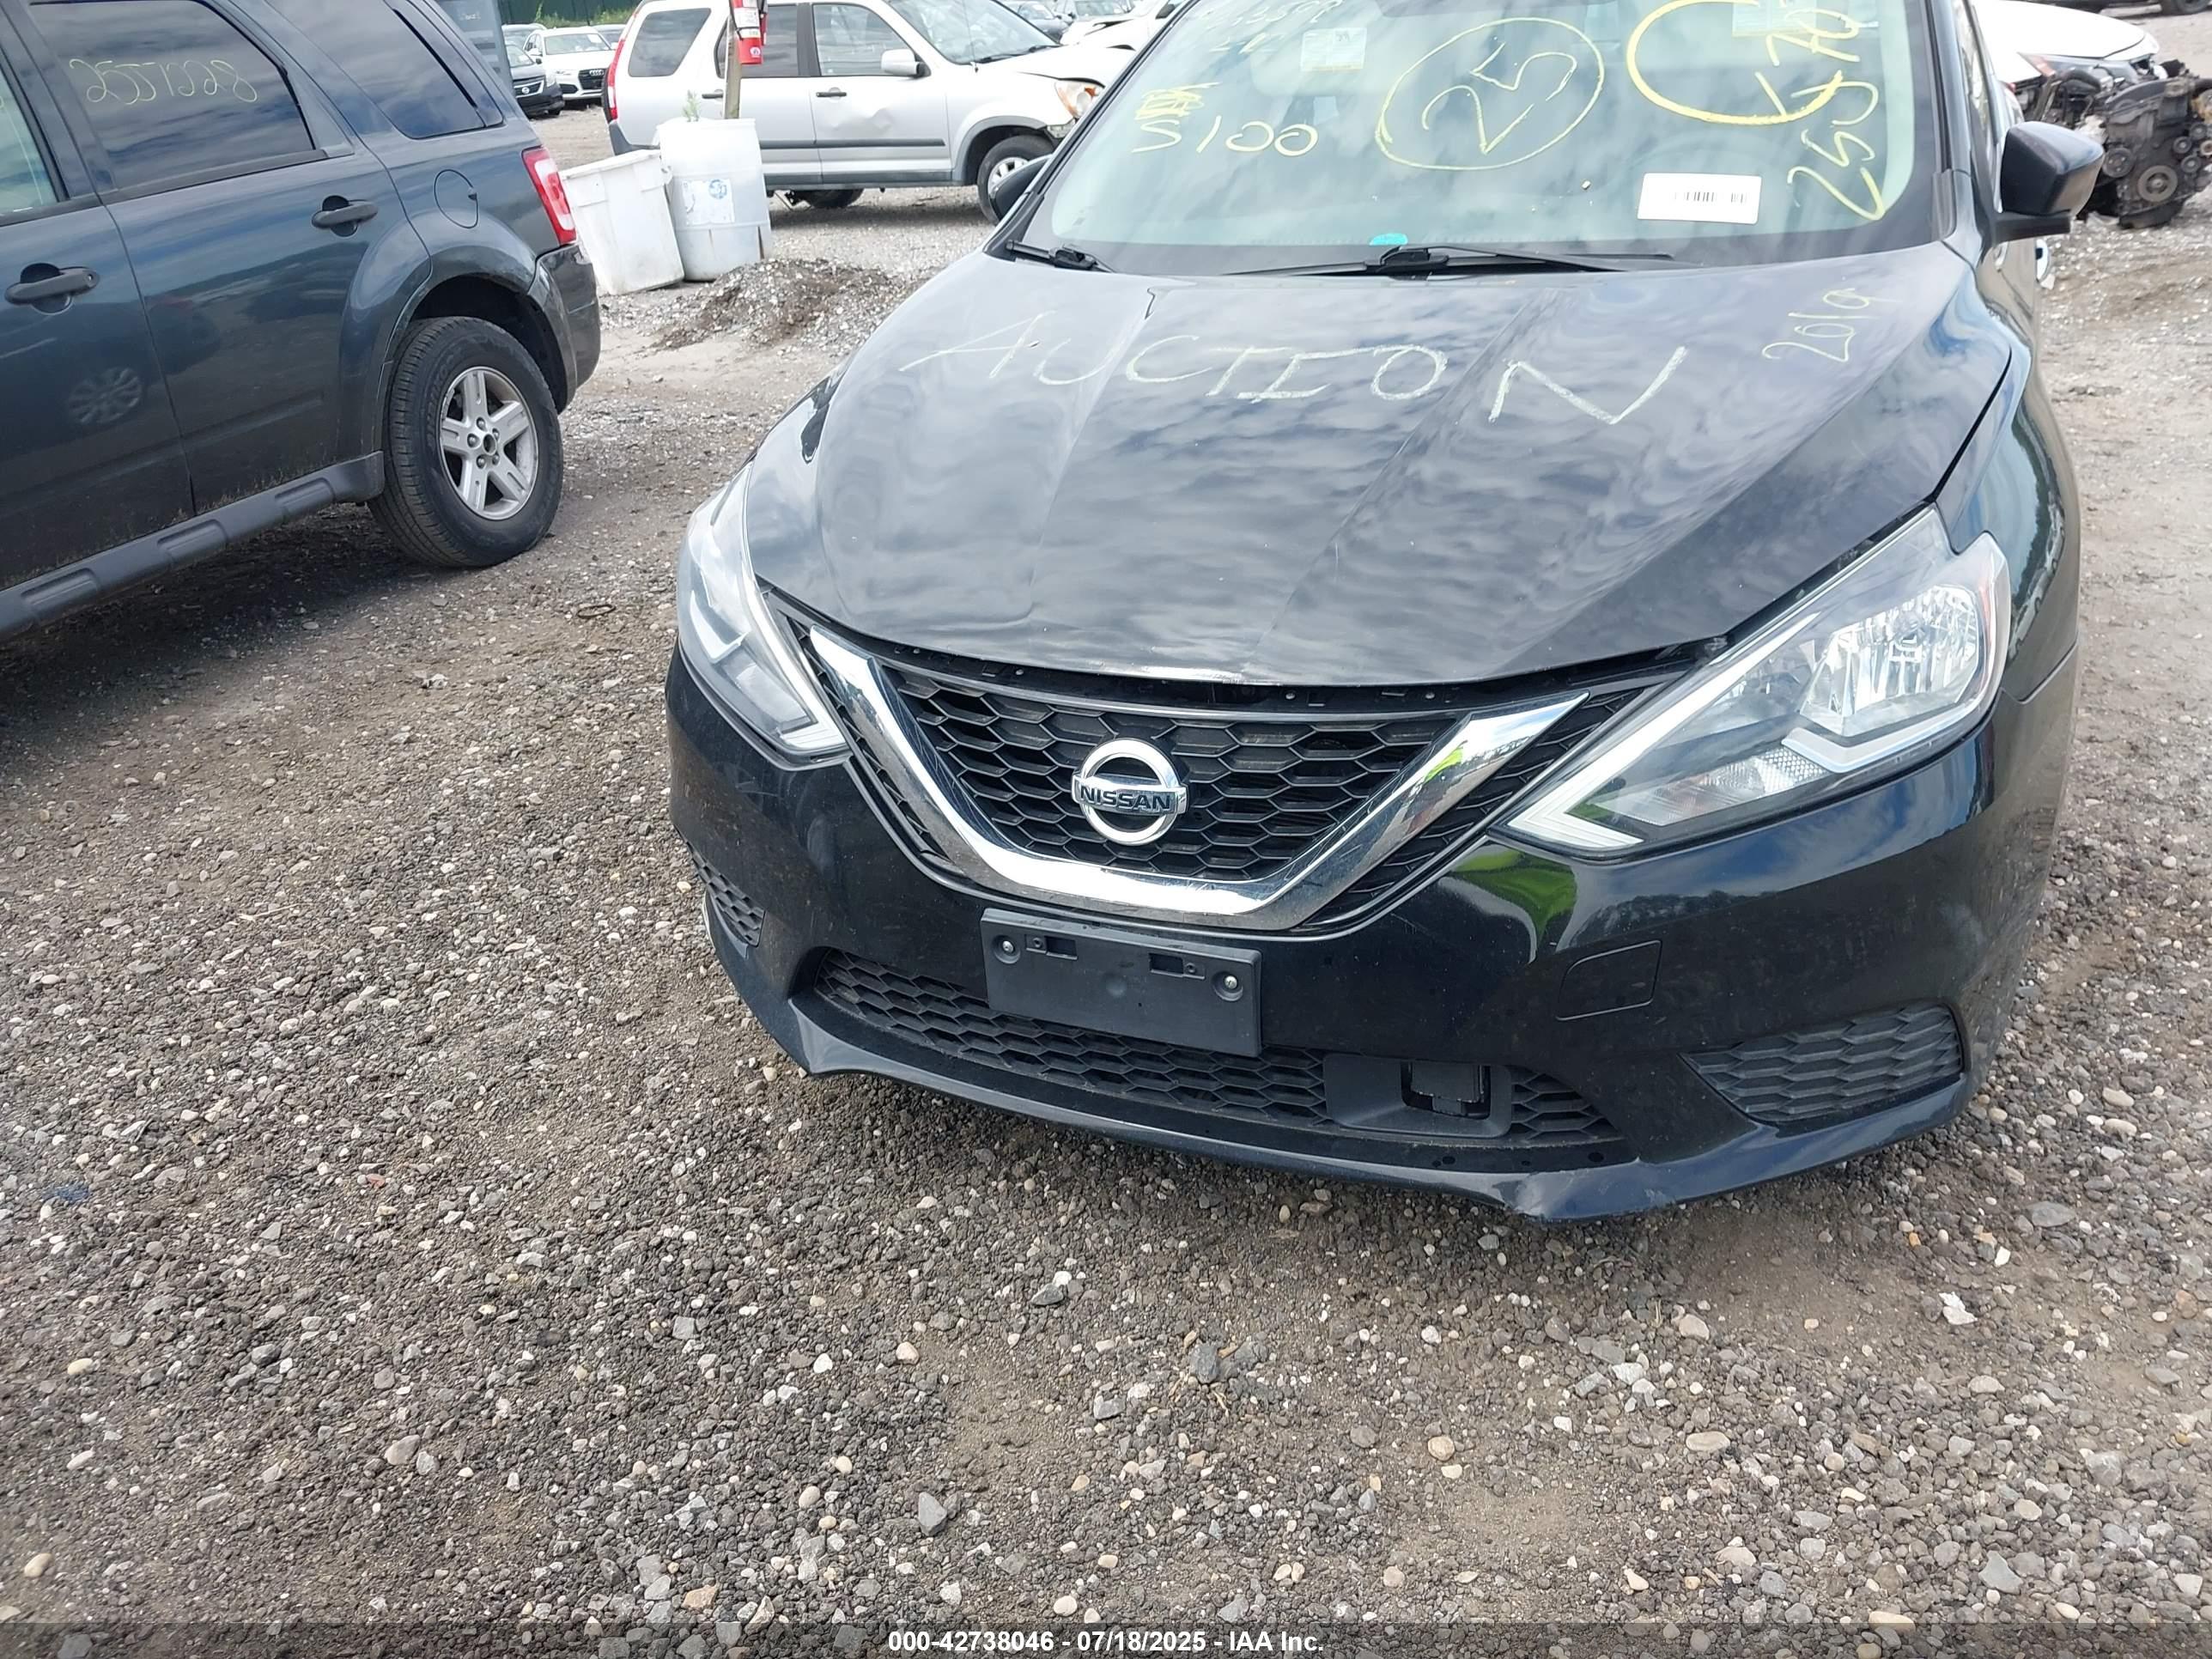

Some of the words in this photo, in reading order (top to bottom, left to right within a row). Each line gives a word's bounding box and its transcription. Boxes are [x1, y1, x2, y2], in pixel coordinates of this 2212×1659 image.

[1422, 42, 1578, 155] 25
[1762, 288, 1898, 362] 2019
[1079, 786, 1171, 811] NISSAN
